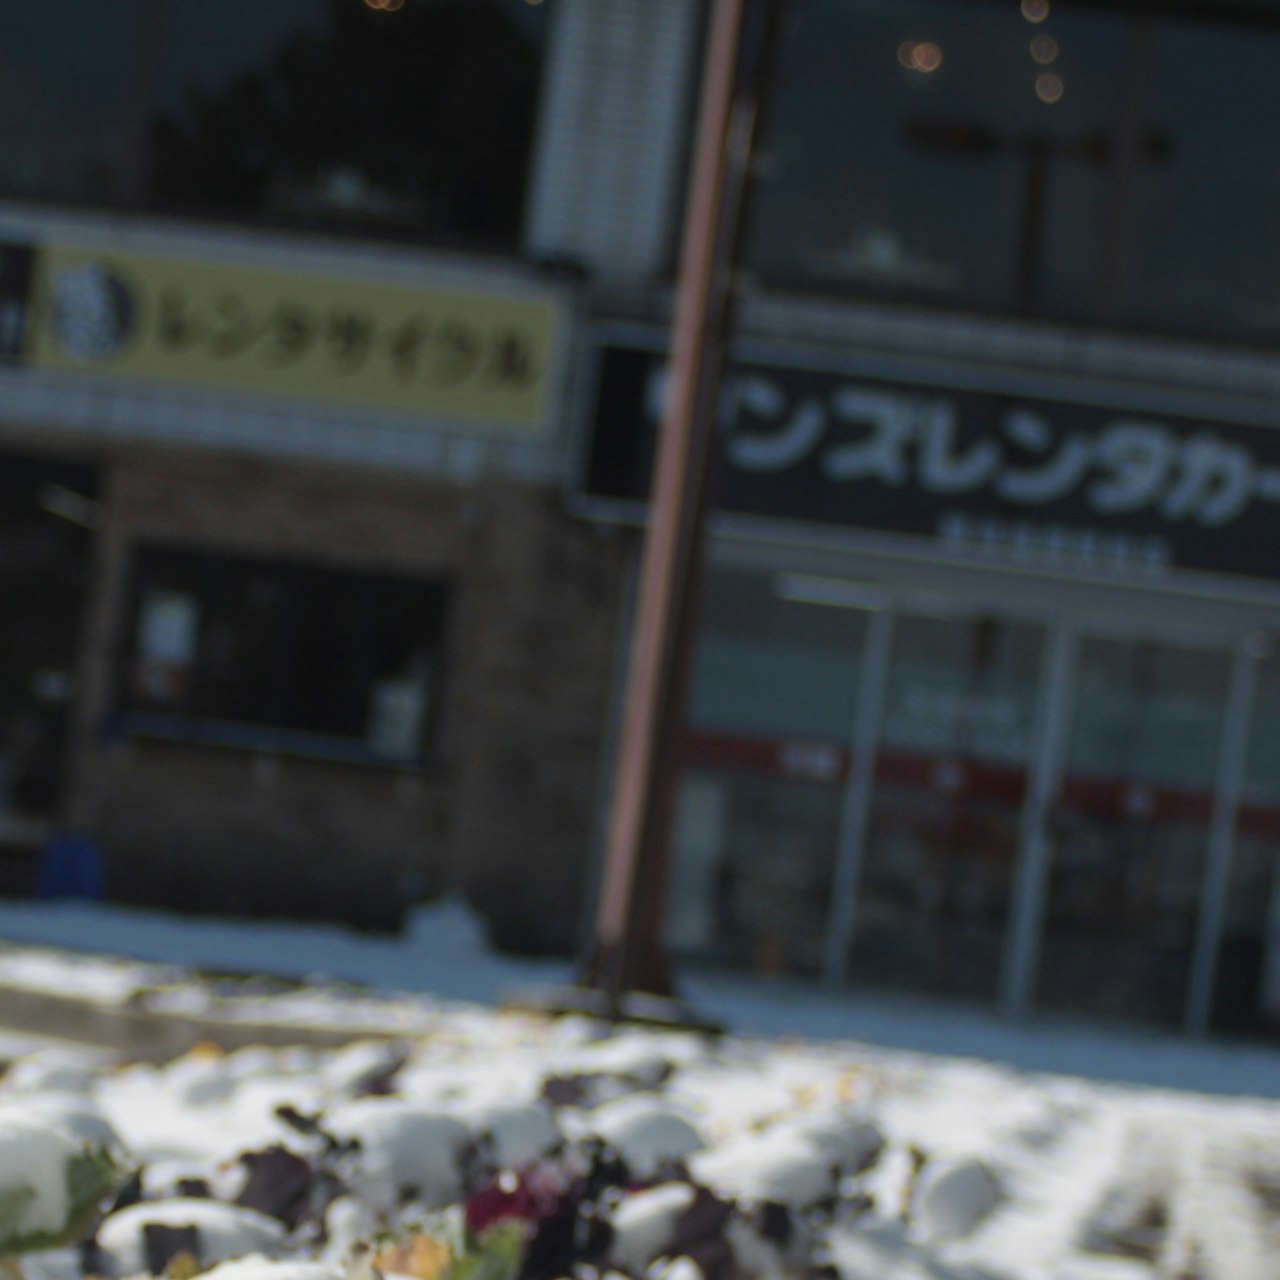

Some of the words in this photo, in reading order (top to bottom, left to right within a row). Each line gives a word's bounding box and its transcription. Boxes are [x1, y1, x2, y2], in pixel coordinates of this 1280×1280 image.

[156, 294, 542, 393] レンタサイクル
